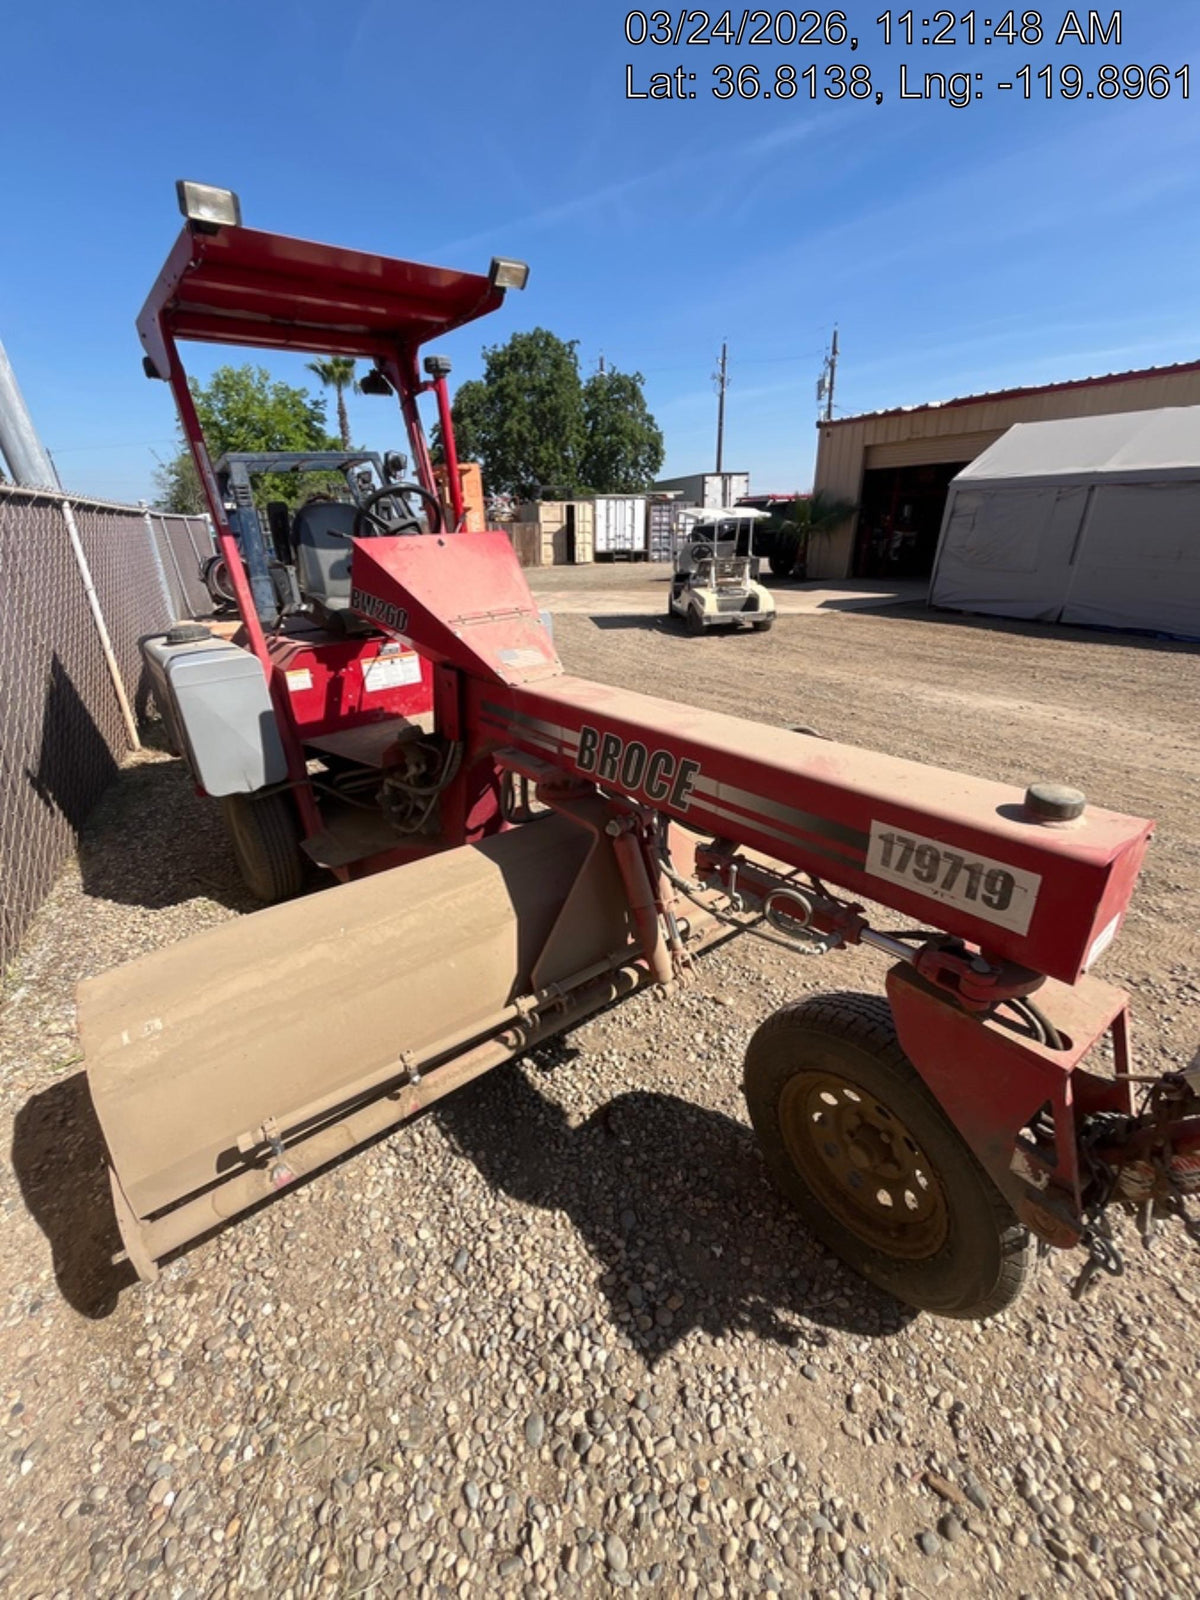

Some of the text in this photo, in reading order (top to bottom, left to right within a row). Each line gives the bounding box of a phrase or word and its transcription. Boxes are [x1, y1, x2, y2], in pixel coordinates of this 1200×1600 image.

[351, 587, 408, 632] BW260
[576, 725, 701, 812] BROCE
[878, 832, 1016, 911] 179719
